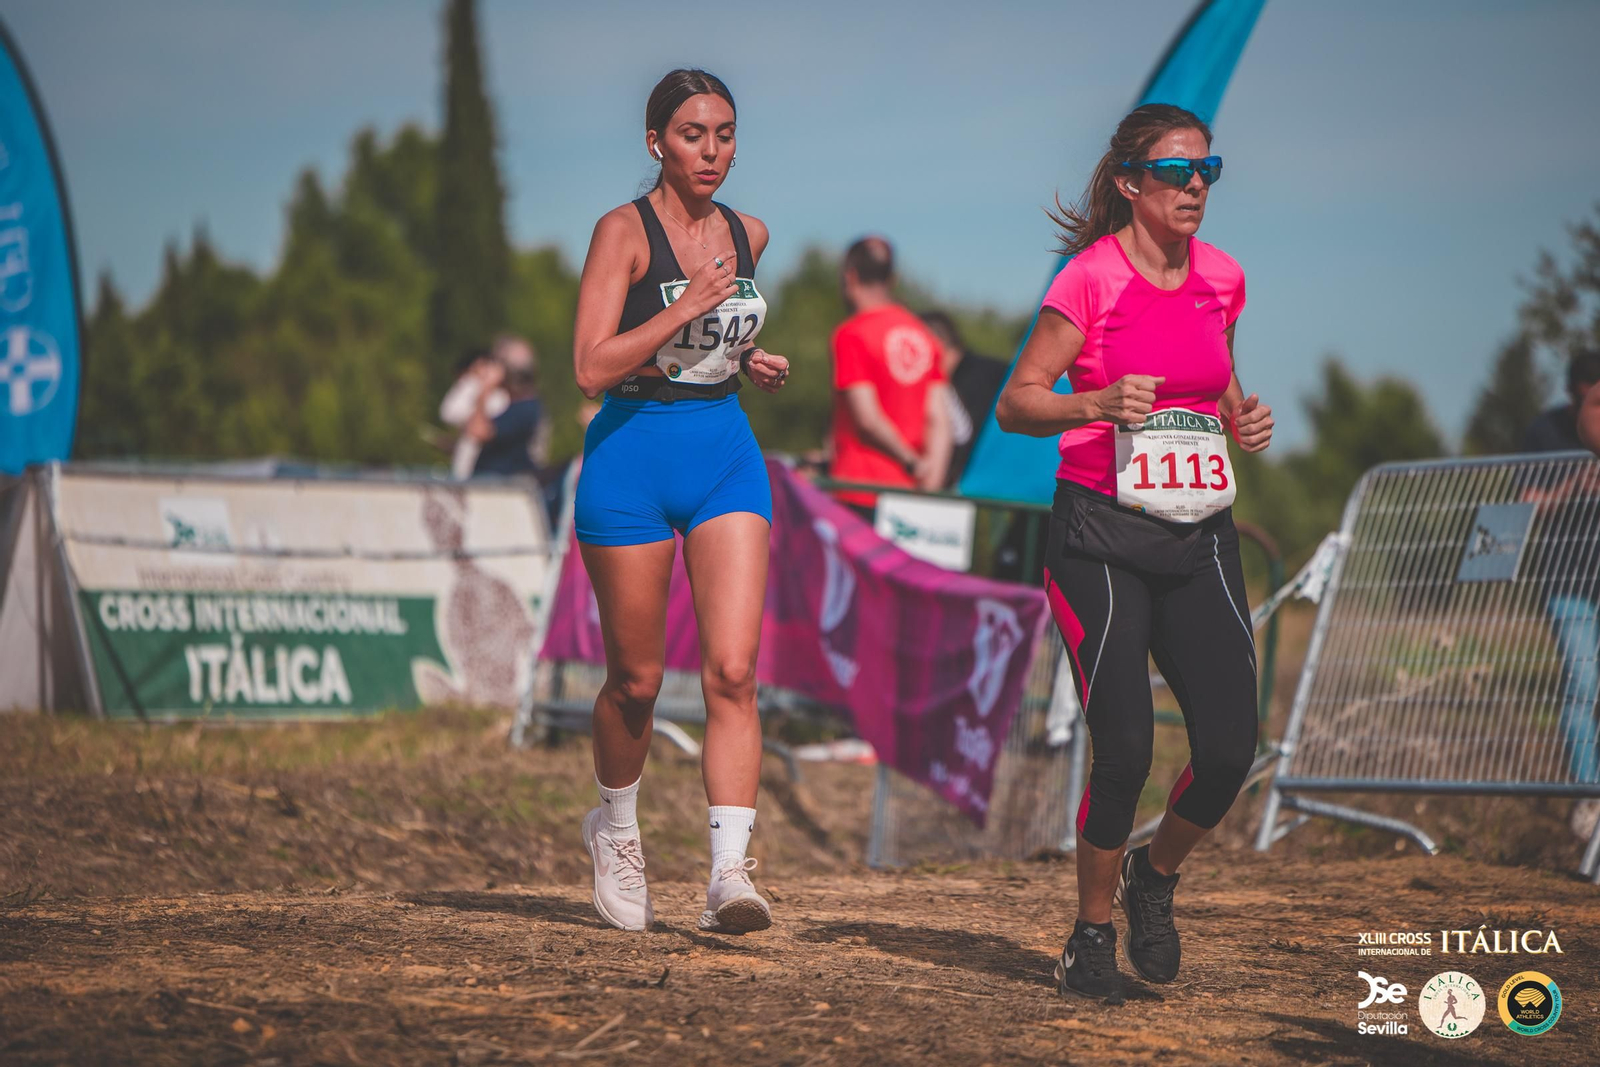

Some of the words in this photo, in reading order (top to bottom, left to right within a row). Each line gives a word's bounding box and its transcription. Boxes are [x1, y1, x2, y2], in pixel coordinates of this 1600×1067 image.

[674, 313, 759, 351] 1542
[621, 384, 640, 394] ipso
[1153, 411, 1203, 429] ITÁLICA
[1132, 452, 1228, 491] 1113
[100, 596, 192, 631] CROSS
[194, 597, 407, 634] INTERNACIONAL
[184, 632, 351, 704] ITÁLICA
